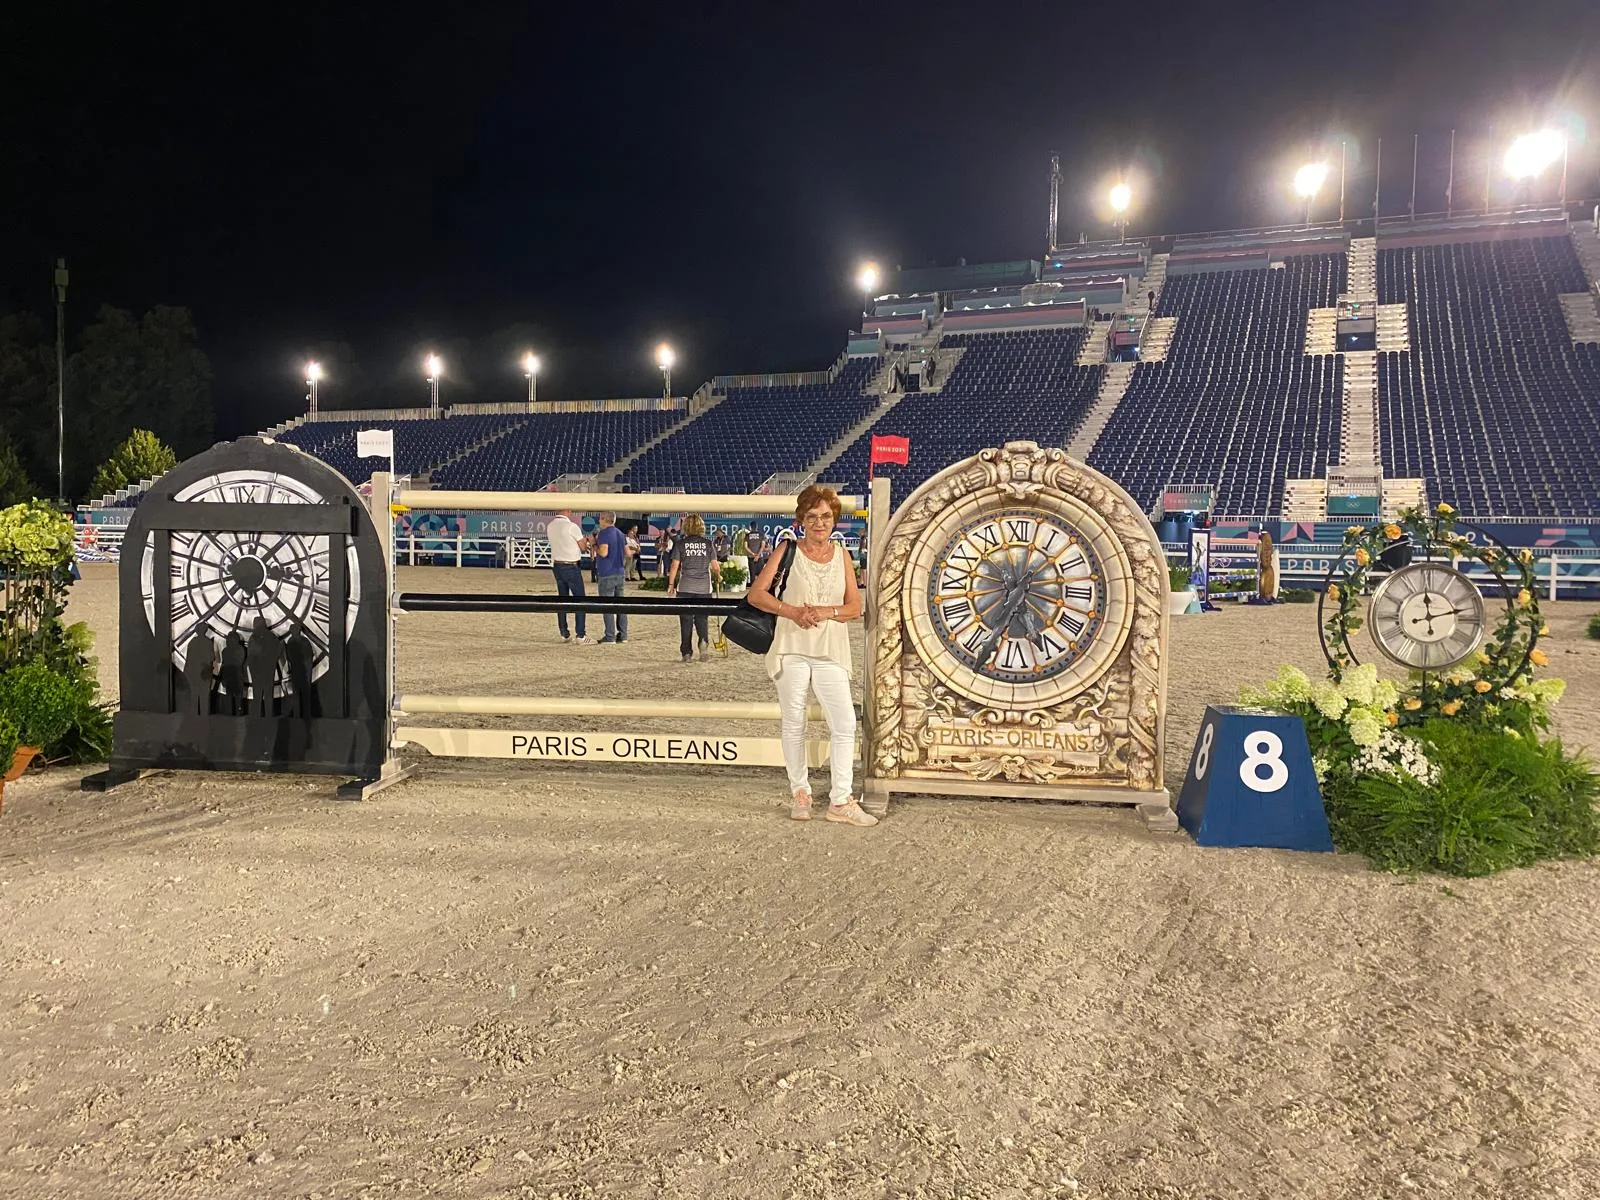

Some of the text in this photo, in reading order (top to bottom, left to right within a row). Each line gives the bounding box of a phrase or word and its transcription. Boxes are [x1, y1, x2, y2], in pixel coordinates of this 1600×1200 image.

[481, 521, 546, 533] PARIS 20
[972, 524, 1000, 551] XI
[1006, 520, 1031, 543] XII
[685, 542, 706, 550] PARIS
[1042, 529, 1060, 551] I
[685, 549, 706, 557] 2024
[951, 544, 979, 569] X
[1059, 553, 1086, 574] II
[942, 571, 968, 591] IX
[1064, 585, 1092, 602] III
[1056, 611, 1086, 637] IIII
[1042, 634, 1066, 660] V
[512, 736, 587, 756] PARIS
[612, 738, 738, 761] ORLEANS
[1195, 723, 1214, 780] 8
[1240, 731, 1288, 793] 8
